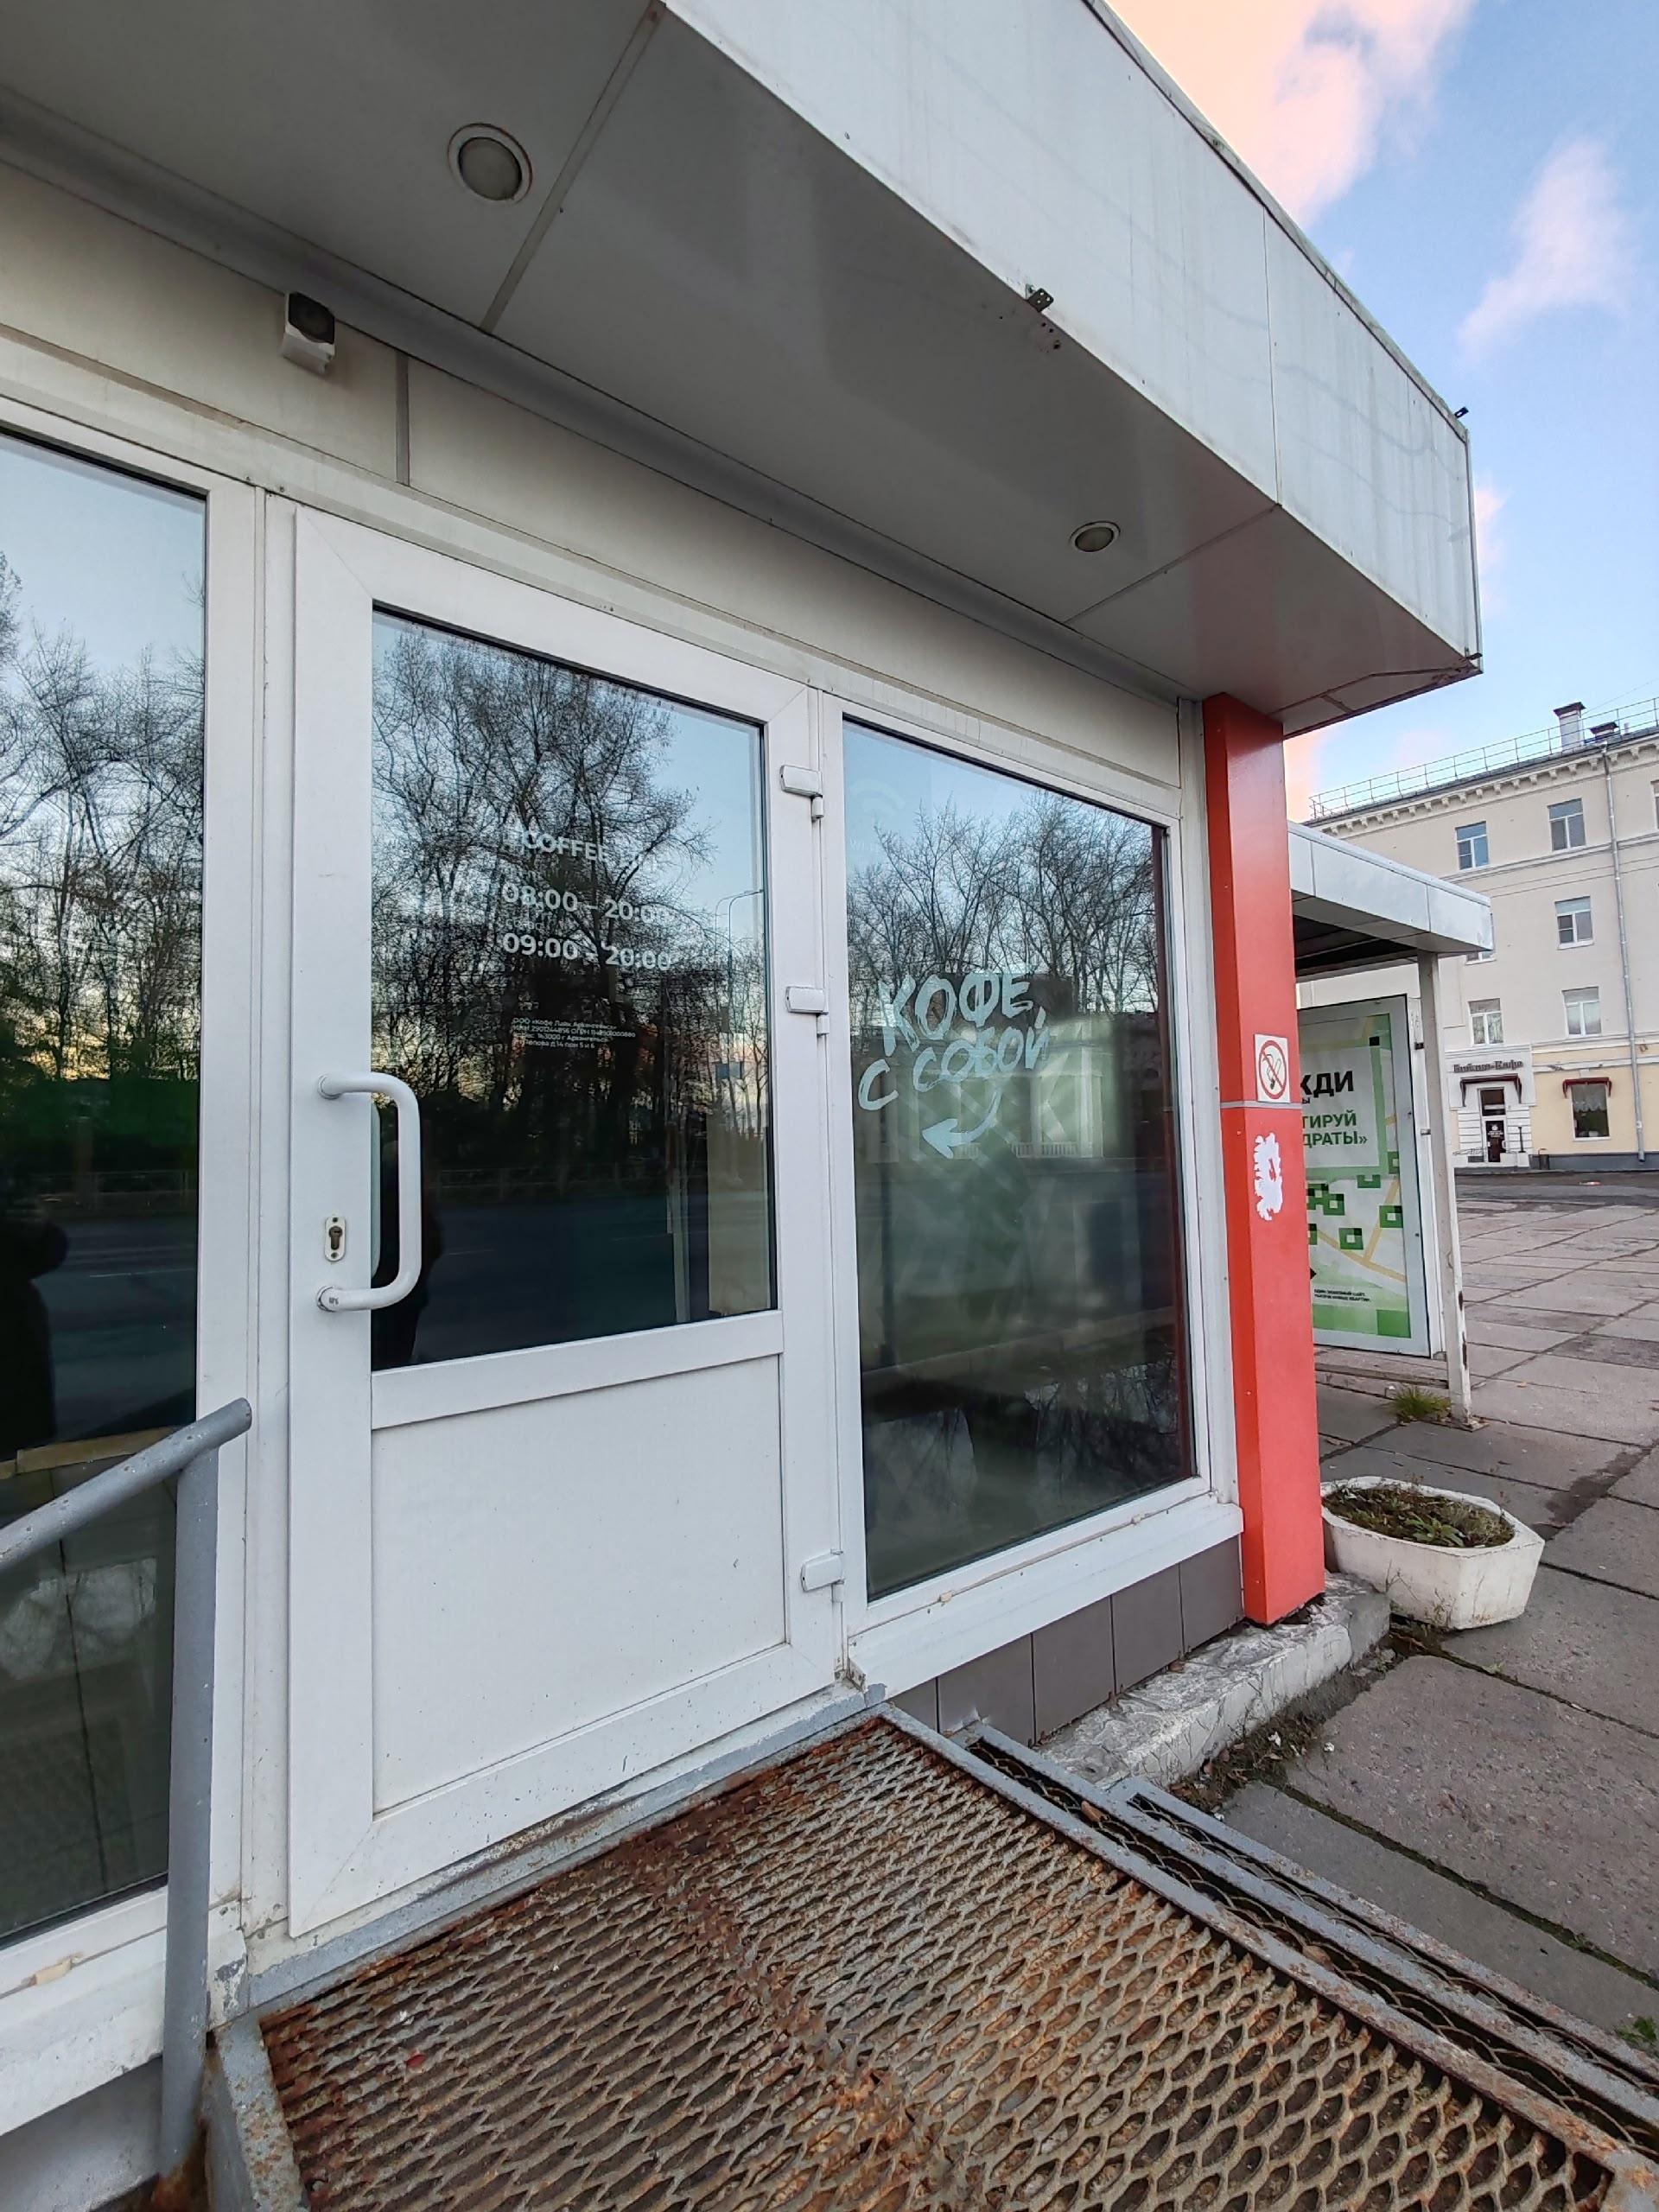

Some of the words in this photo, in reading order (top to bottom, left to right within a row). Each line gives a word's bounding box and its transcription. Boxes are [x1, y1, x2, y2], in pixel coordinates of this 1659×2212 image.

[502, 882, 577, 912] 08:00
[502, 933, 578, 960] 09:00
[605, 945, 671, 971] 20:00
[878, 972, 1033, 1056] КОФЕ
